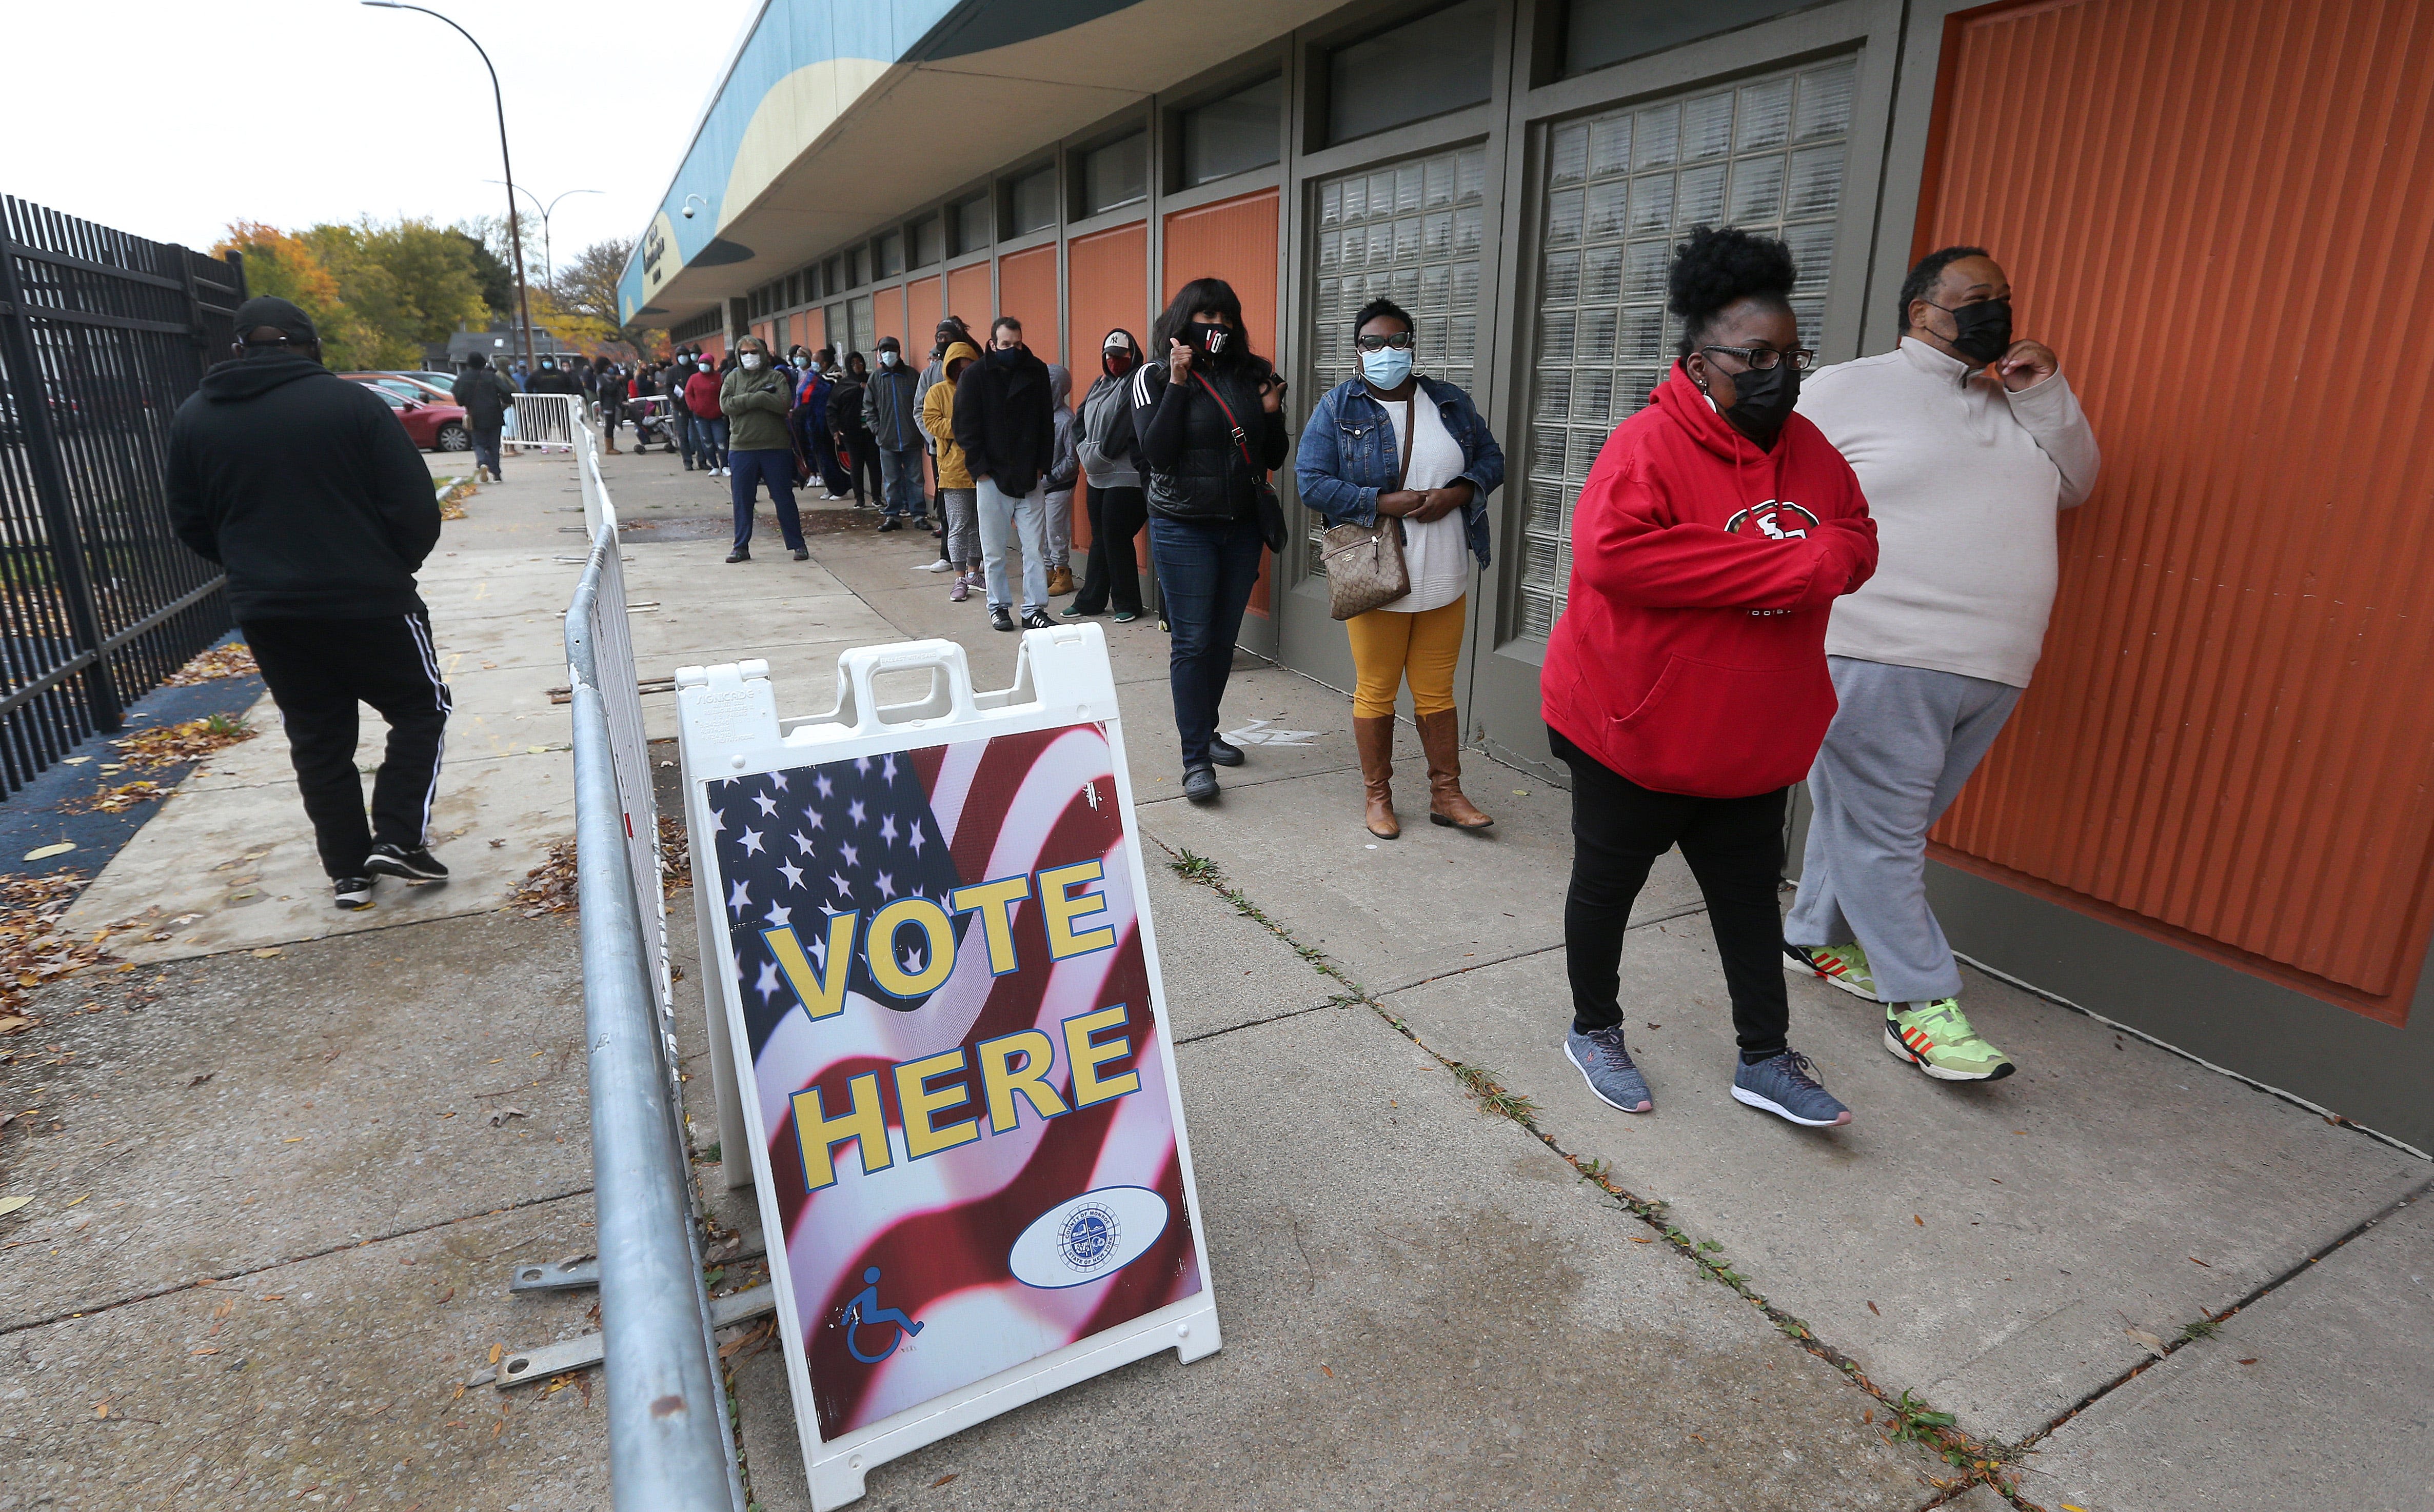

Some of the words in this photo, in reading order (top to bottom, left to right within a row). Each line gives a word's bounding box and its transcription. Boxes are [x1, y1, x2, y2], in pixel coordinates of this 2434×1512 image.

[1205, 329, 1228, 353] VOTE
[697, 689, 755, 705] SIGNICADE
[758, 857, 1118, 1022] VOTE
[788, 1002, 1142, 1195] HERE
[1065, 1216, 1080, 1239] COUNTY
[1090, 1210, 1110, 1225] MONROE
[1068, 1252, 1083, 1264] STATE
[1093, 1252, 1104, 1263] NEW
[1104, 1236, 1113, 1252] YORK
